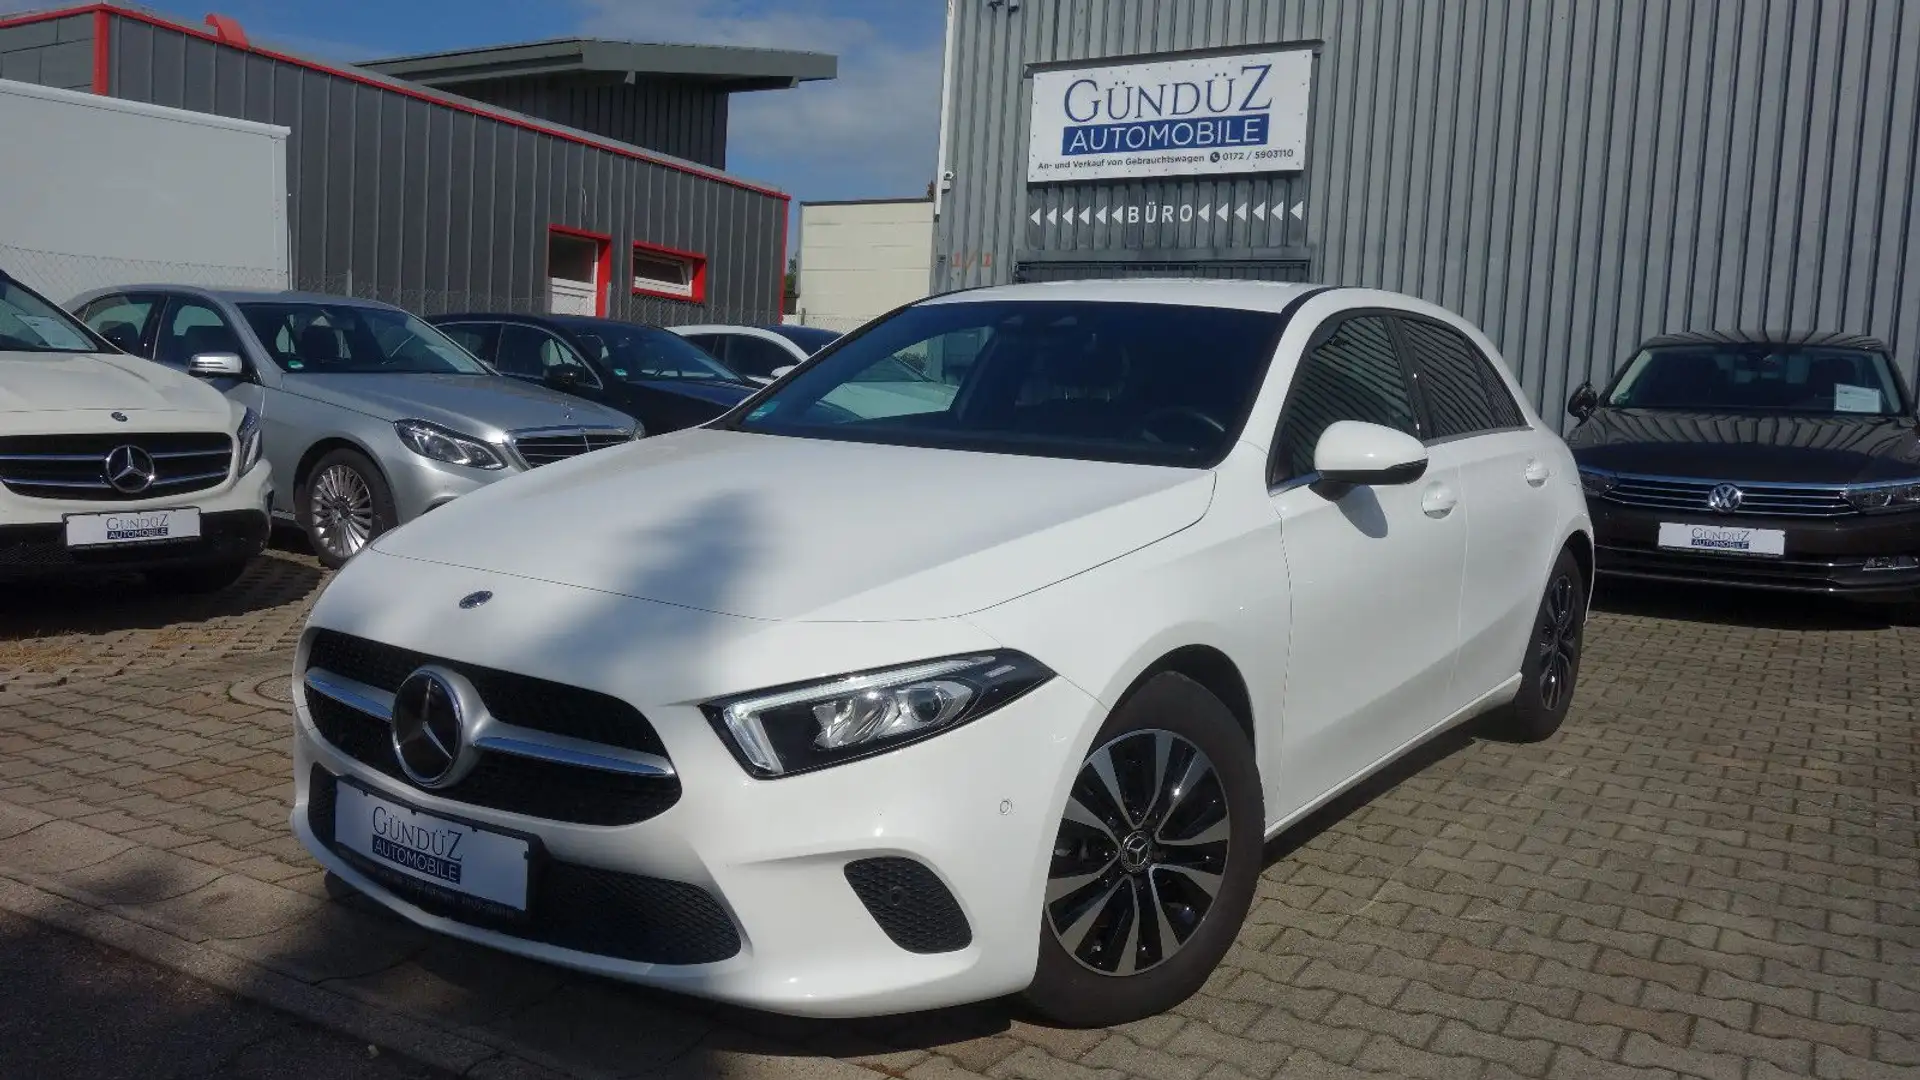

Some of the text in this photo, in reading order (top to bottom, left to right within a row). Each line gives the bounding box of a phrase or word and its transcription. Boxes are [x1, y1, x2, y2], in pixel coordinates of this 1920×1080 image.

[1064, 64, 1273, 123] GÜNDÜZ
[1069, 118, 1261, 153] AUTOMOBILE
[1055, 161, 1071, 169] und
[1073, 159, 1104, 168] Verkauf
[1125, 155, 1205, 166] Gebrauchtswagen
[1222, 152, 1244, 161] 0172
[1128, 202, 1192, 224] BÜRO
[109, 528, 168, 539] AUTOMOBILE
[373, 806, 463, 862] GÜNDÜZ
[375, 839, 459, 881] AUTOMOBILE
